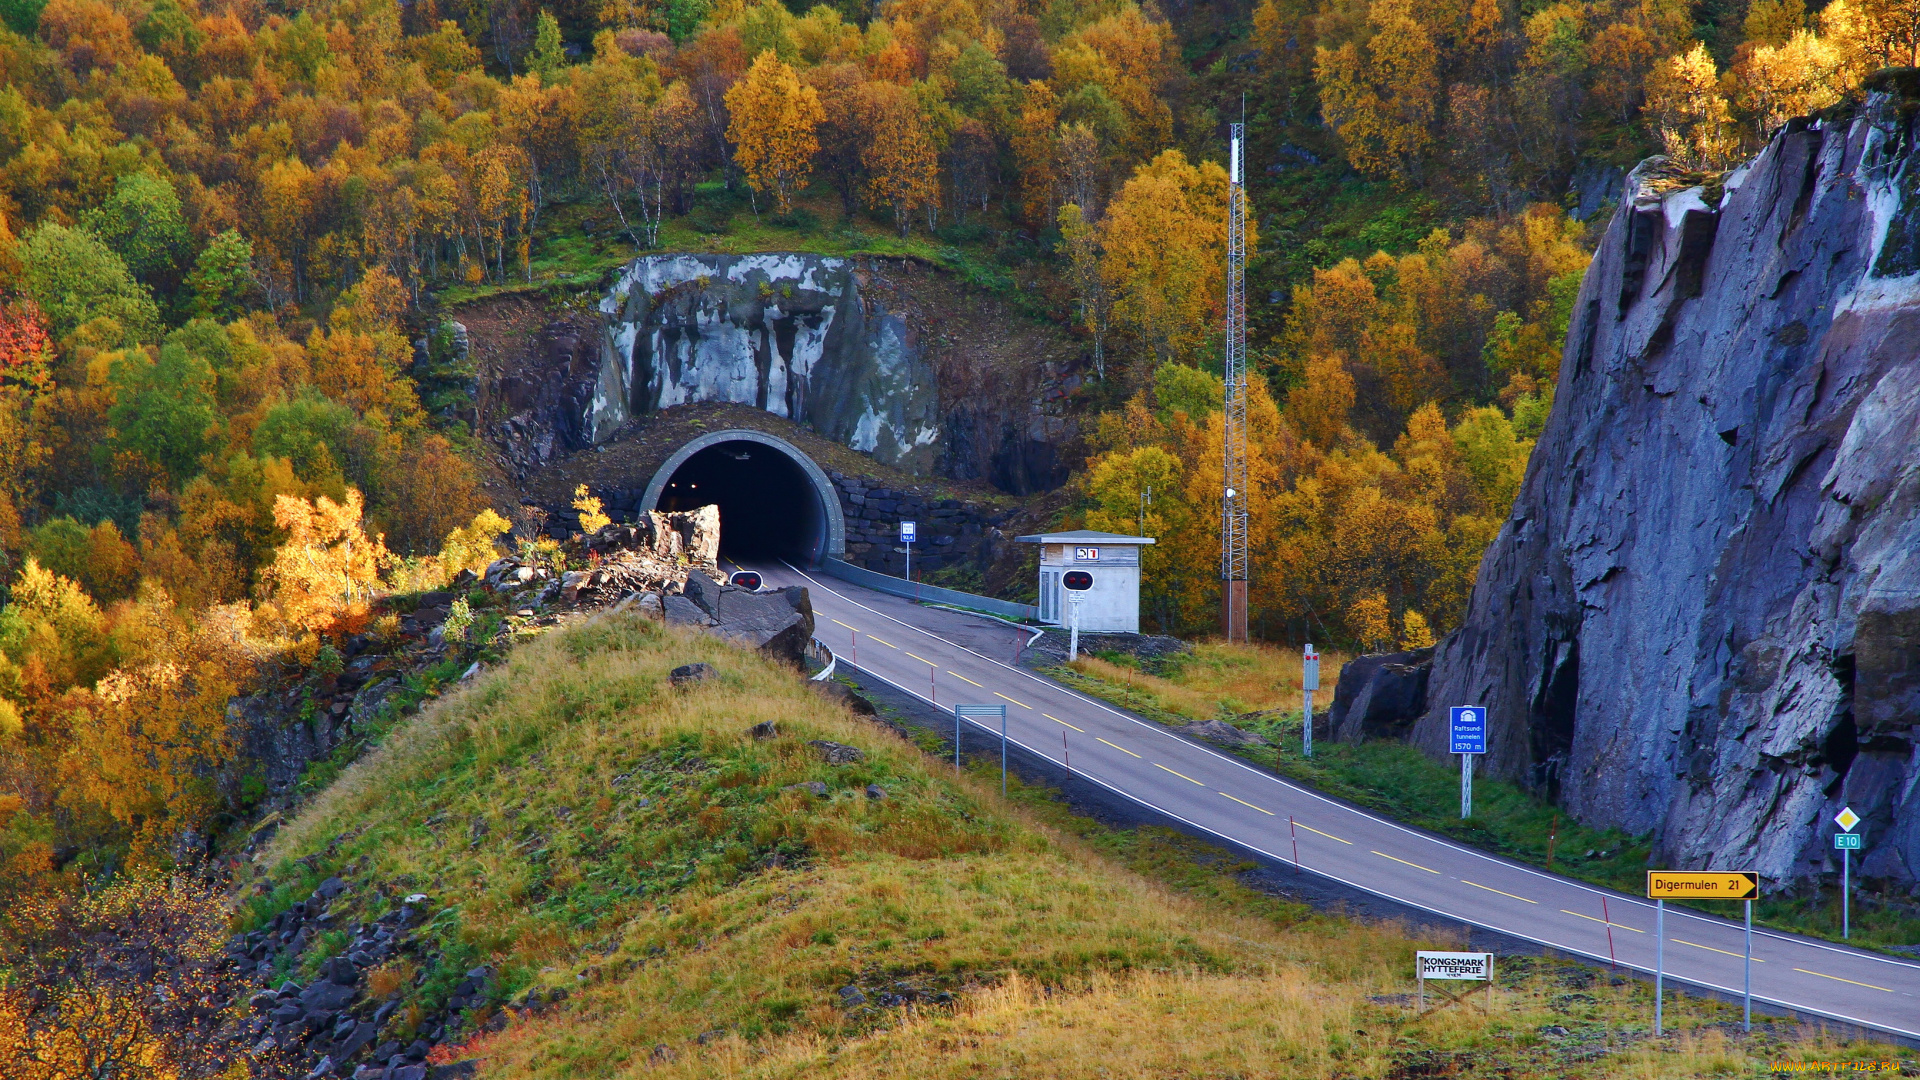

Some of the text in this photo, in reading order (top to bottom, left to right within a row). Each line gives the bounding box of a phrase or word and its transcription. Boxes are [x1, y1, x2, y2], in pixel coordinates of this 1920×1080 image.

[1455, 742, 1472, 750] 1570
[1655, 879, 1739, 892] Digermulen 21
[1424, 957, 1484, 967] KONGSMARK
[1424, 965, 1482, 974] HYTTEFERIE
